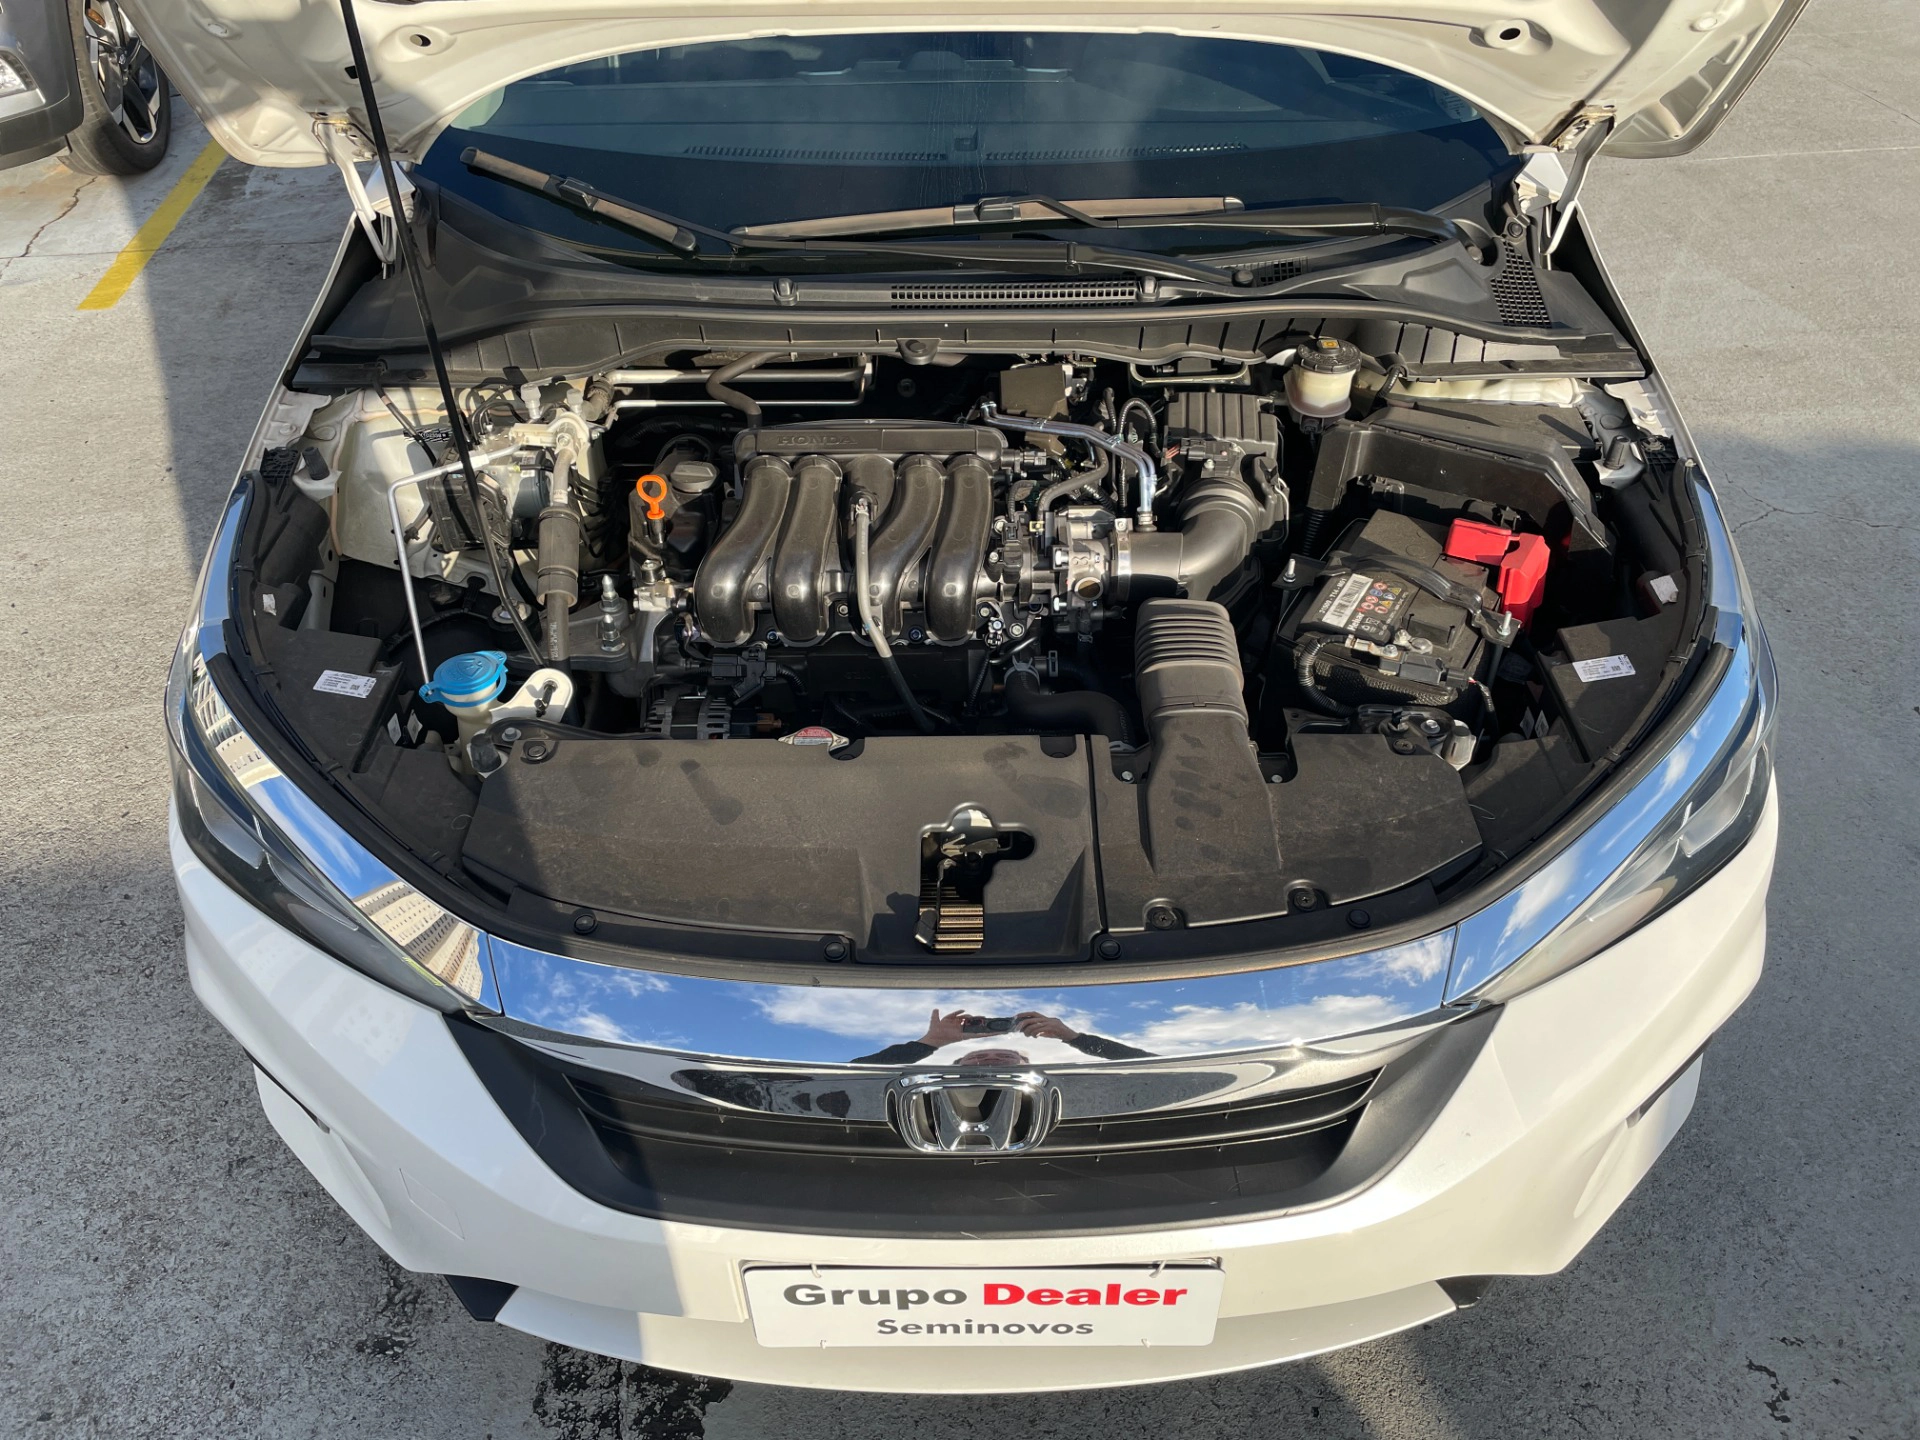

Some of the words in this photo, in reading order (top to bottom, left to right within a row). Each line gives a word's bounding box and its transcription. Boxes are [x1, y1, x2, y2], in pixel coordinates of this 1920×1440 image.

[777, 435, 858, 446] HONDA
[783, 1284, 968, 1310] Grupo
[983, 1283, 1188, 1306] Dealer
[877, 1319, 1094, 1335] Seminovos
